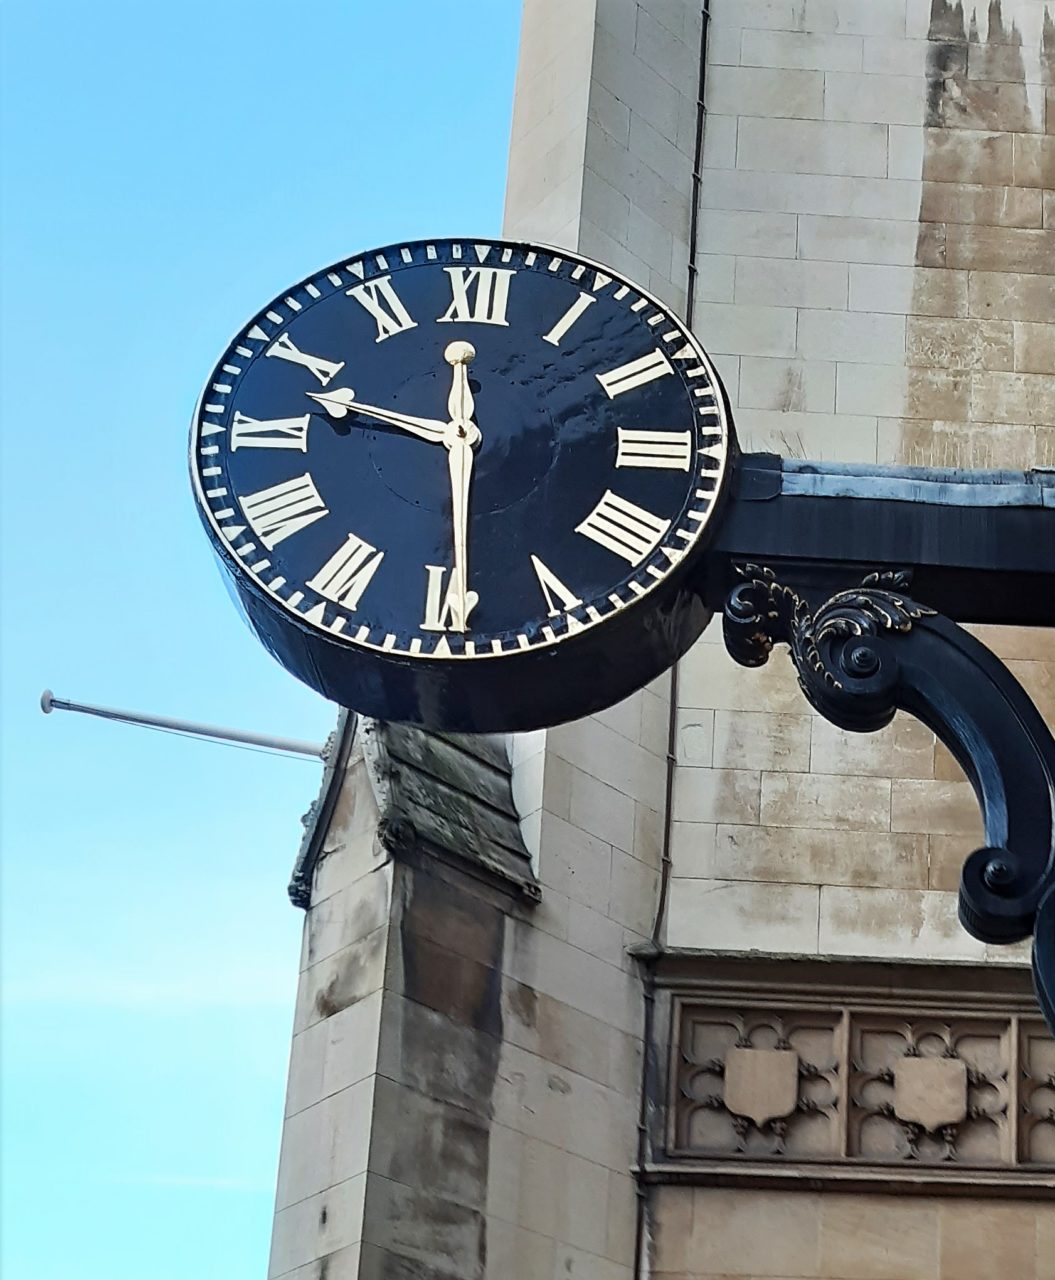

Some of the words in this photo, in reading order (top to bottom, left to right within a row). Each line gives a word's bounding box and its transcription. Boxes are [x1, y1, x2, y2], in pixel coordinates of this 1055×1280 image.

[346, 275, 418, 343] XI
[437, 267, 516, 326] XII
[543, 292, 596, 346] I
[266, 333, 344, 386] X
[596, 348, 674, 399] II
[231, 411, 310, 452] IX
[616, 427, 691, 471] III
[239, 473, 329, 551] VIII
[575, 490, 671, 567] IIII
[305, 533, 384, 611] VII
[531, 555, 583, 617] V
